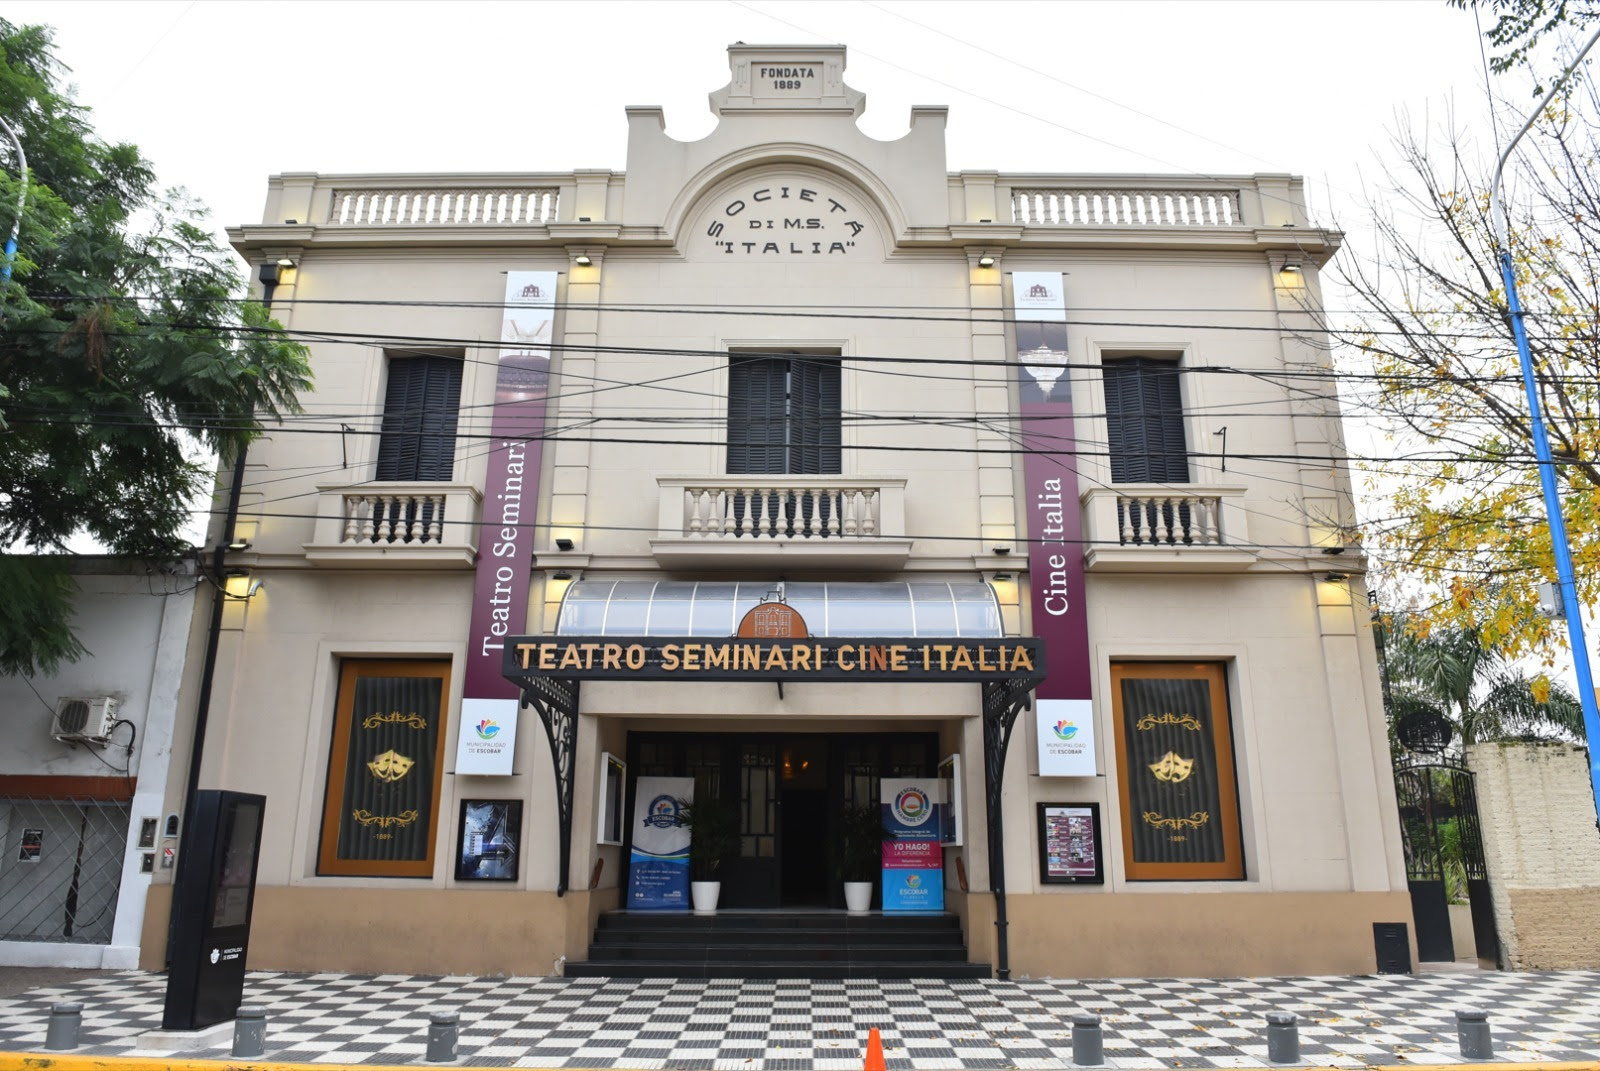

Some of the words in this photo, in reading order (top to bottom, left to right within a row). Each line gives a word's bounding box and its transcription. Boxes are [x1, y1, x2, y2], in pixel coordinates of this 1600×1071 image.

[760, 67, 815, 79] FONDATA
[773, 80, 802, 90] 1889
[749, 220, 774, 229] DI
[784, 218, 825, 230] M.S.
[492, 441, 527, 558] Seminari
[1037, 477, 1065, 546] Italia
[1042, 554, 1069, 616] Cine
[482, 565, 515, 657] Teatro
[517, 643, 646, 671] TEATRO
[661, 643, 822, 672] SEMINARI
[837, 644, 909, 672] CINE
[923, 644, 1034, 672] ITALIA
[893, 843, 904, 851] YO
[905, 843, 931, 851] HAGO!
